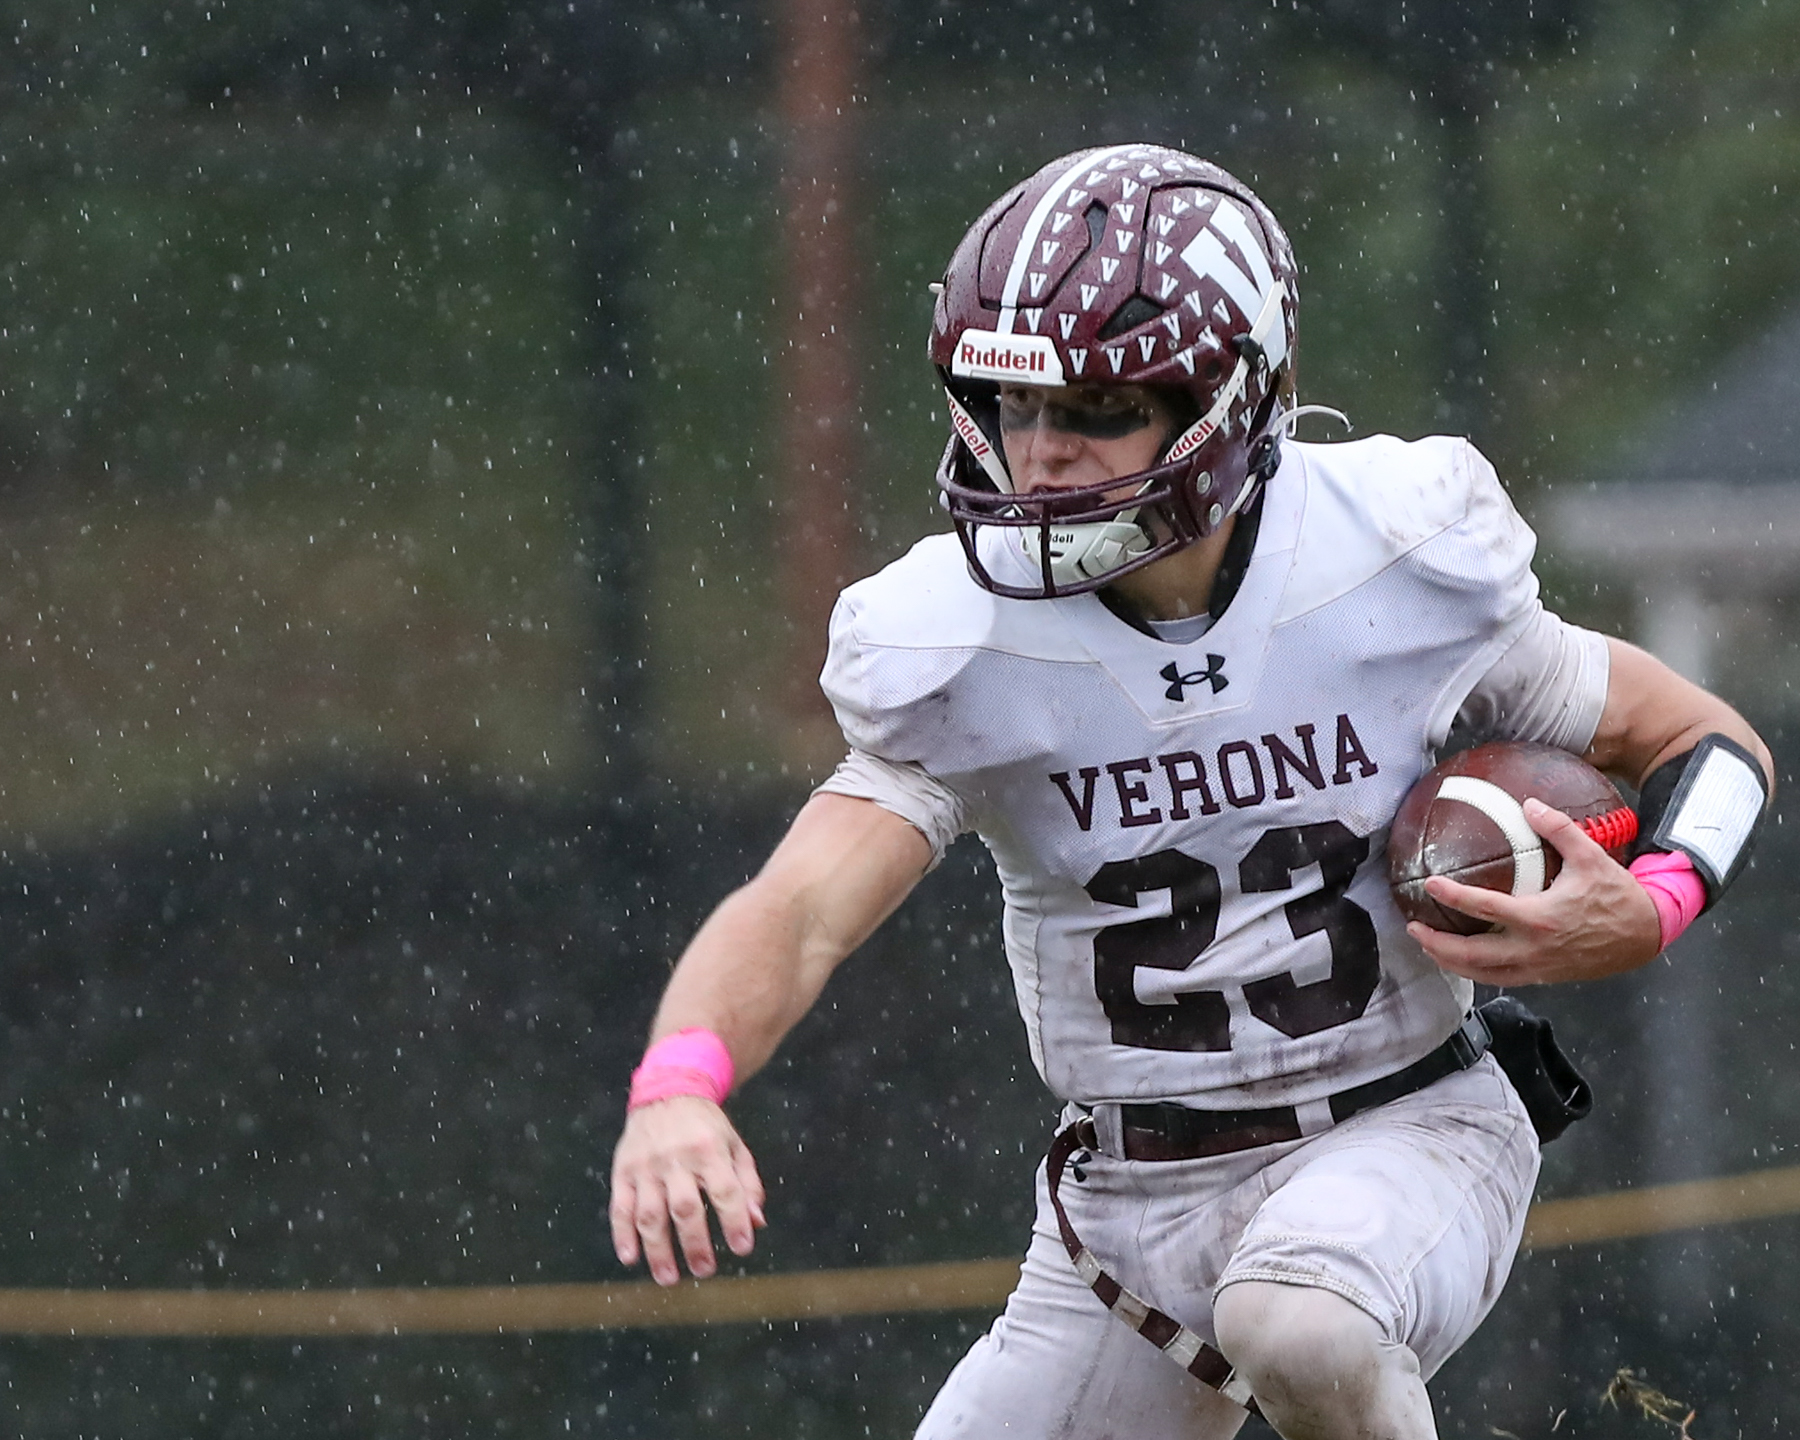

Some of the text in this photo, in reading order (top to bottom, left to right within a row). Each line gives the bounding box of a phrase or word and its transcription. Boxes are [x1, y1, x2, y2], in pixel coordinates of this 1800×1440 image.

[1086, 171, 1108, 186] V
[1122, 177, 1139, 199] V
[1066, 189, 1088, 207] V
[1172, 196, 1190, 215] V
[1052, 211, 1073, 234] V
[1116, 203, 1135, 224] V
[1158, 213, 1176, 236] V
[1042, 240, 1060, 264] V
[1115, 229, 1134, 253] V
[1155, 240, 1173, 265] V
[1101, 256, 1120, 282] V
[1029, 272, 1047, 298] V
[1080, 284, 1099, 311] V
[1161, 273, 1179, 299] V
[1185, 290, 1202, 317] V
[1212, 298, 1231, 325] V
[1025, 307, 1043, 333] V
[1058, 313, 1077, 340] V
[1162, 312, 1181, 340] V
[1138, 336, 1157, 362] V
[1199, 325, 1220, 350] V
[961, 344, 1045, 372] Riddell
[1069, 348, 1088, 375] V
[1106, 347, 1125, 374] V
[1176, 348, 1195, 375] V
[1050, 714, 1378, 831] VERONA
[1083, 819, 1380, 1053] 23
